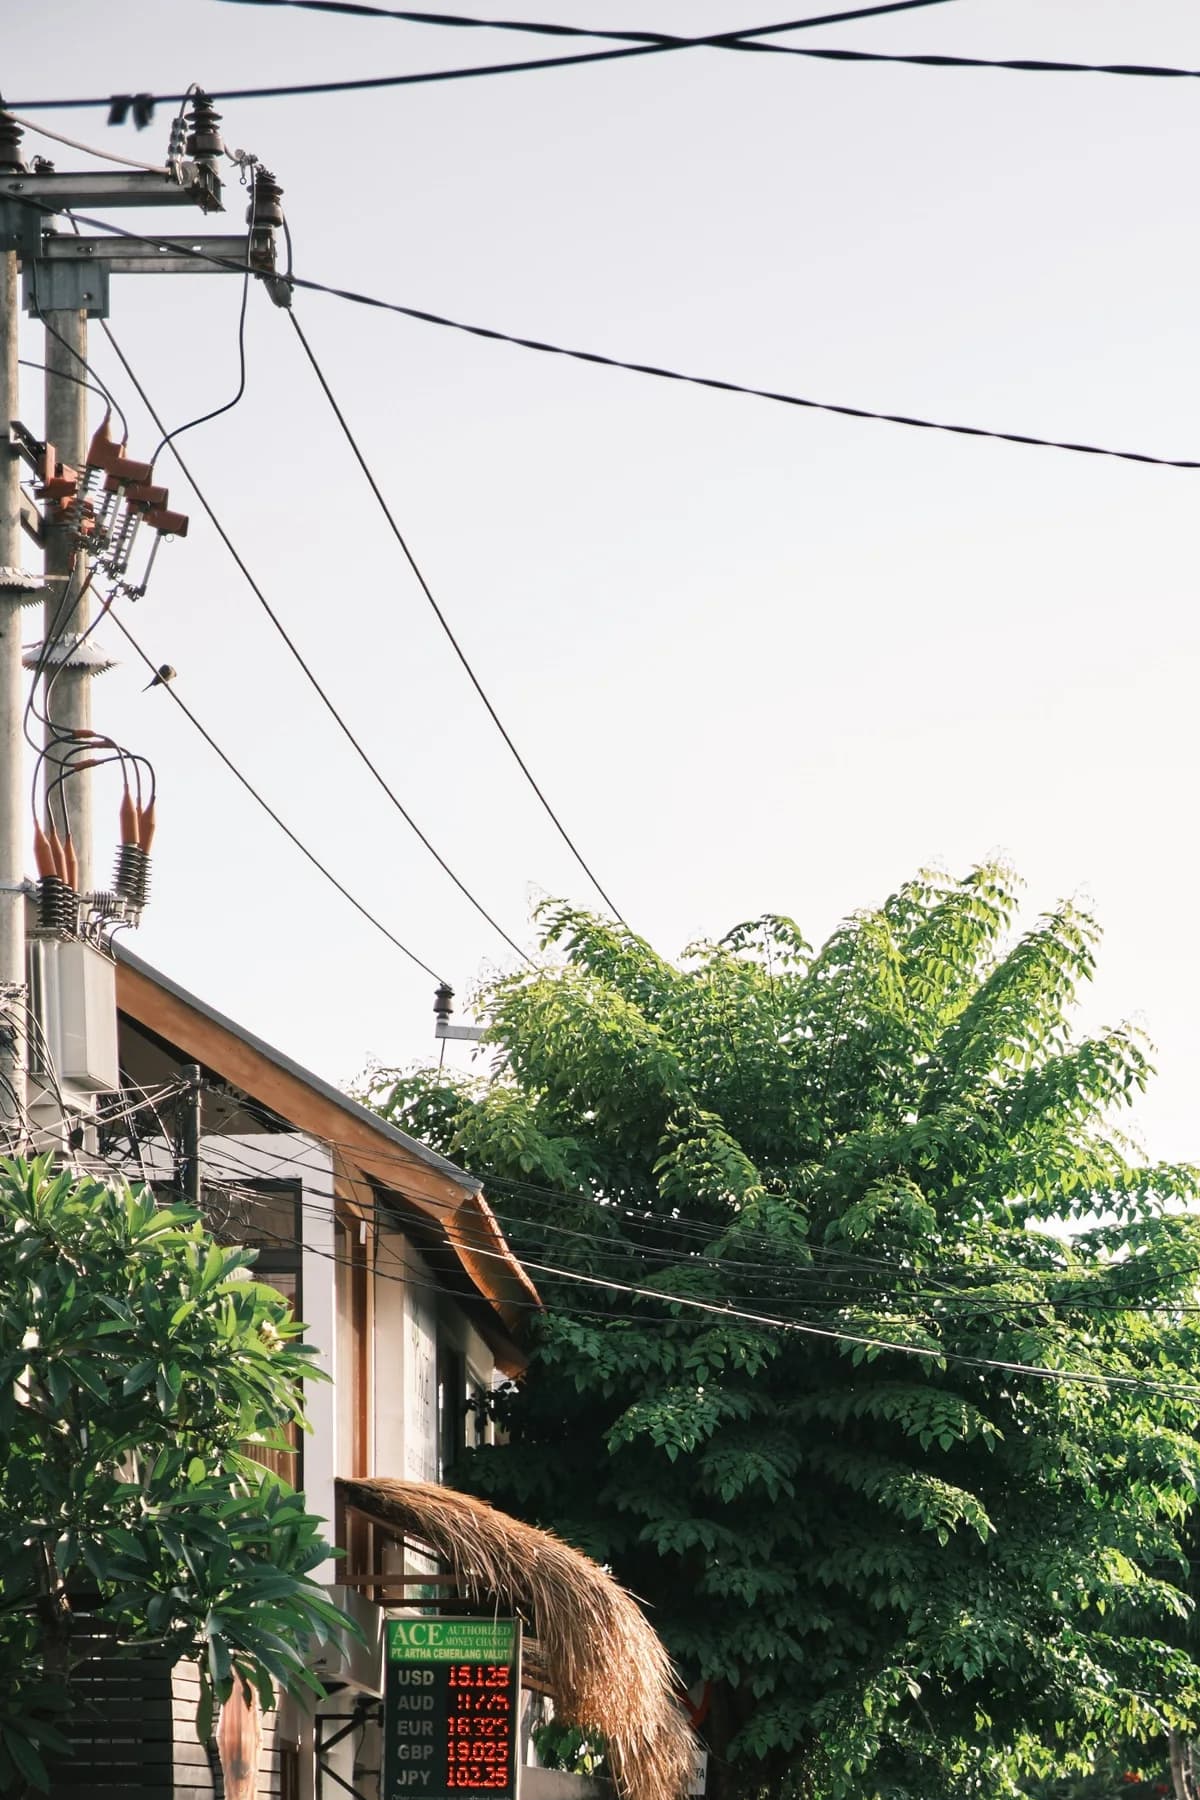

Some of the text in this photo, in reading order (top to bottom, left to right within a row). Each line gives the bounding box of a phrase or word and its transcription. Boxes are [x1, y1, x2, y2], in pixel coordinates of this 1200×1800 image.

[392, 1623, 443, 1646] ACE
[447, 1625, 511, 1635] AUTHORIZED
[445, 1636, 512, 1646] MONEY CHANGE
[404, 1648, 432, 1658] ARTHA
[433, 1649, 481, 1659] CEMERLANG
[483, 1649, 512, 1660] VALUT
[398, 1670, 434, 1685] USD
[398, 1695, 434, 1710] AUD
[397, 1720, 434, 1736] EUR
[397, 1744, 434, 1760] GBP
[397, 1770, 431, 1785] JPY
